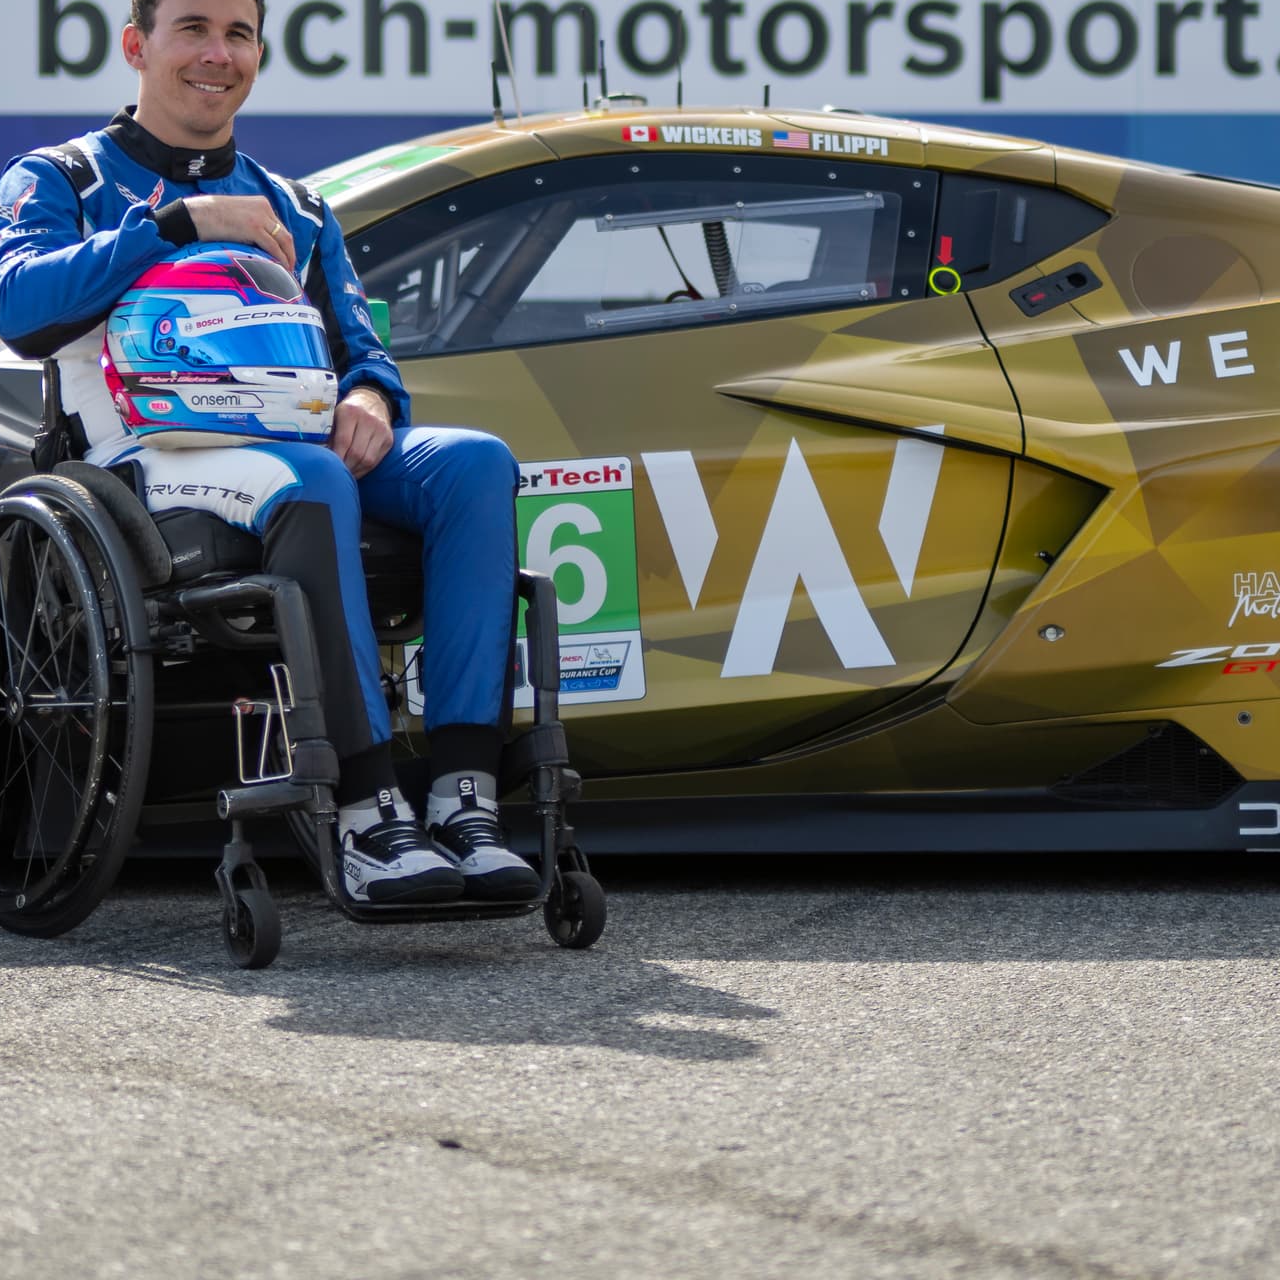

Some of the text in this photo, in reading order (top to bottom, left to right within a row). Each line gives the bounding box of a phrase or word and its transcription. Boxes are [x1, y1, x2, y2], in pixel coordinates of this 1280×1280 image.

[660, 125, 889, 157] WICKENS FILIPPI
[195, 317, 224, 329] BOSCH
[150, 402, 170, 411] BELL
[191, 393, 241, 406] onsemi
[519, 465, 623, 489] erTech
[143, 483, 256, 506] RVETTE
[524, 502, 608, 626] 6
[559, 670, 598, 680] DURANCE
